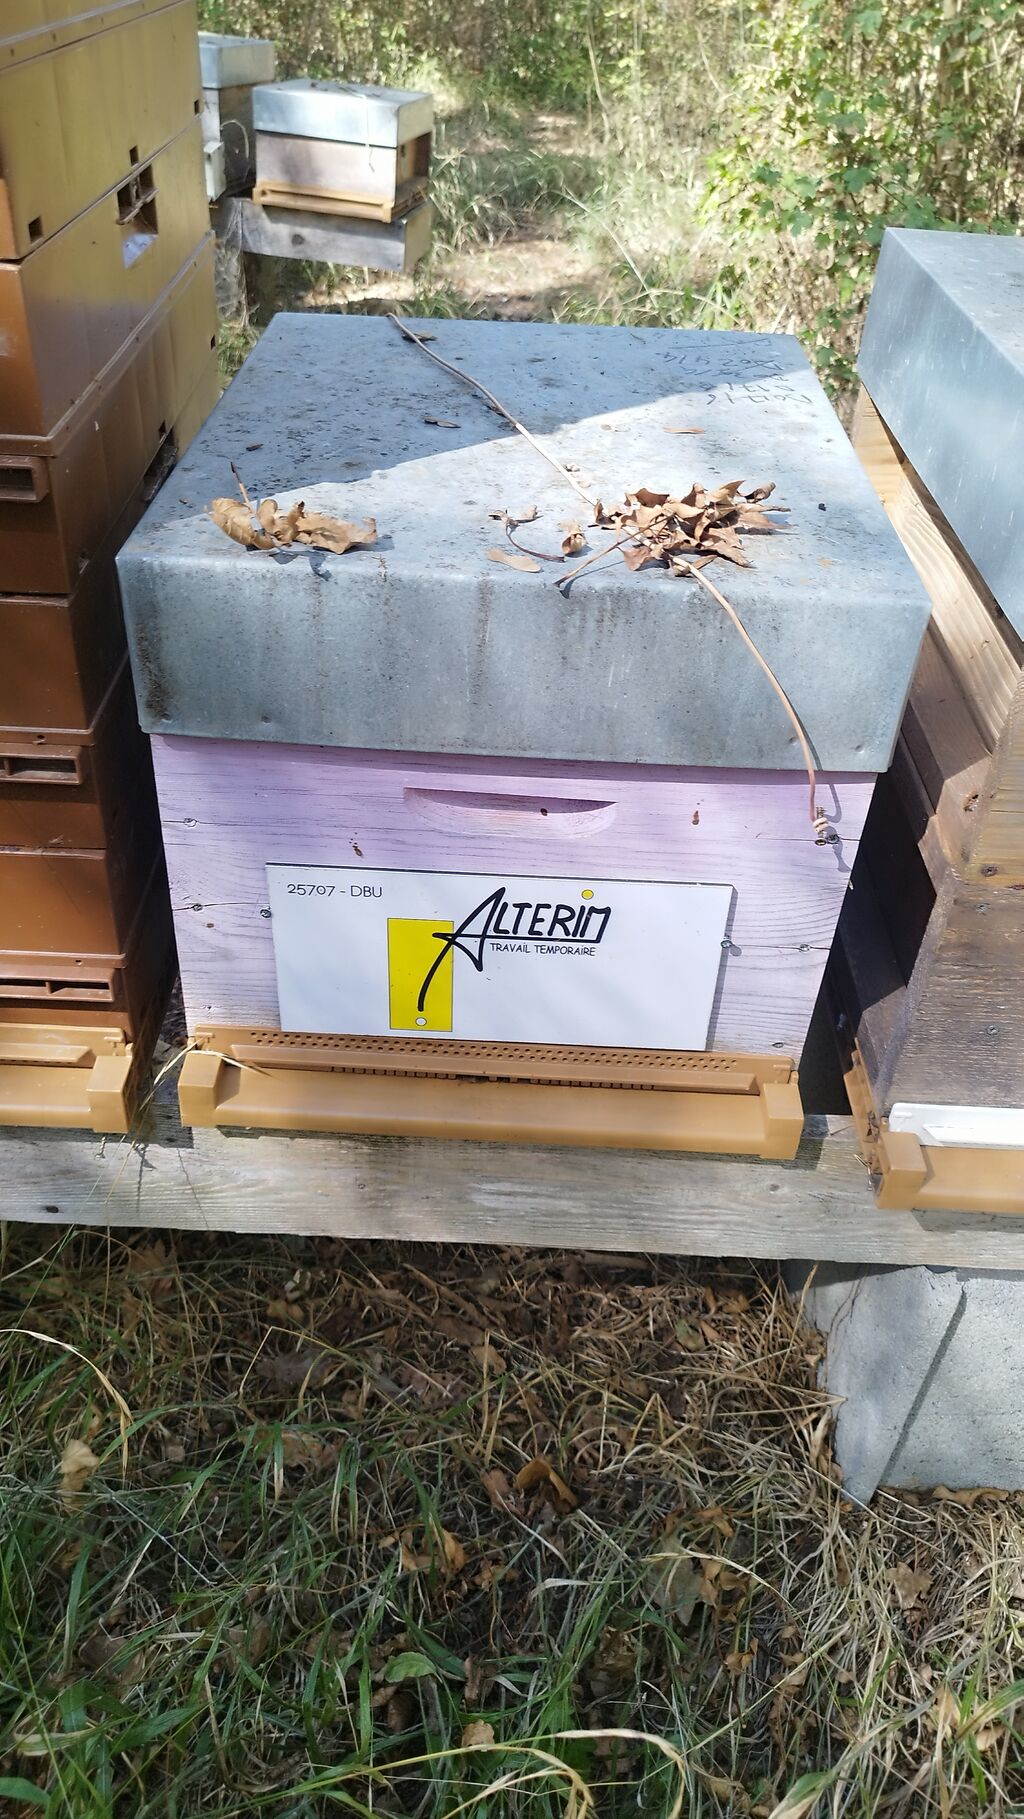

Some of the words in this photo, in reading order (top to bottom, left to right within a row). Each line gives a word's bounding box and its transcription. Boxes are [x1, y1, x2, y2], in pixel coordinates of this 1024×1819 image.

[286, 883, 336, 897] 25707
[350, 885, 383, 898] DBU
[417, 886, 612, 1013] ALTERIM
